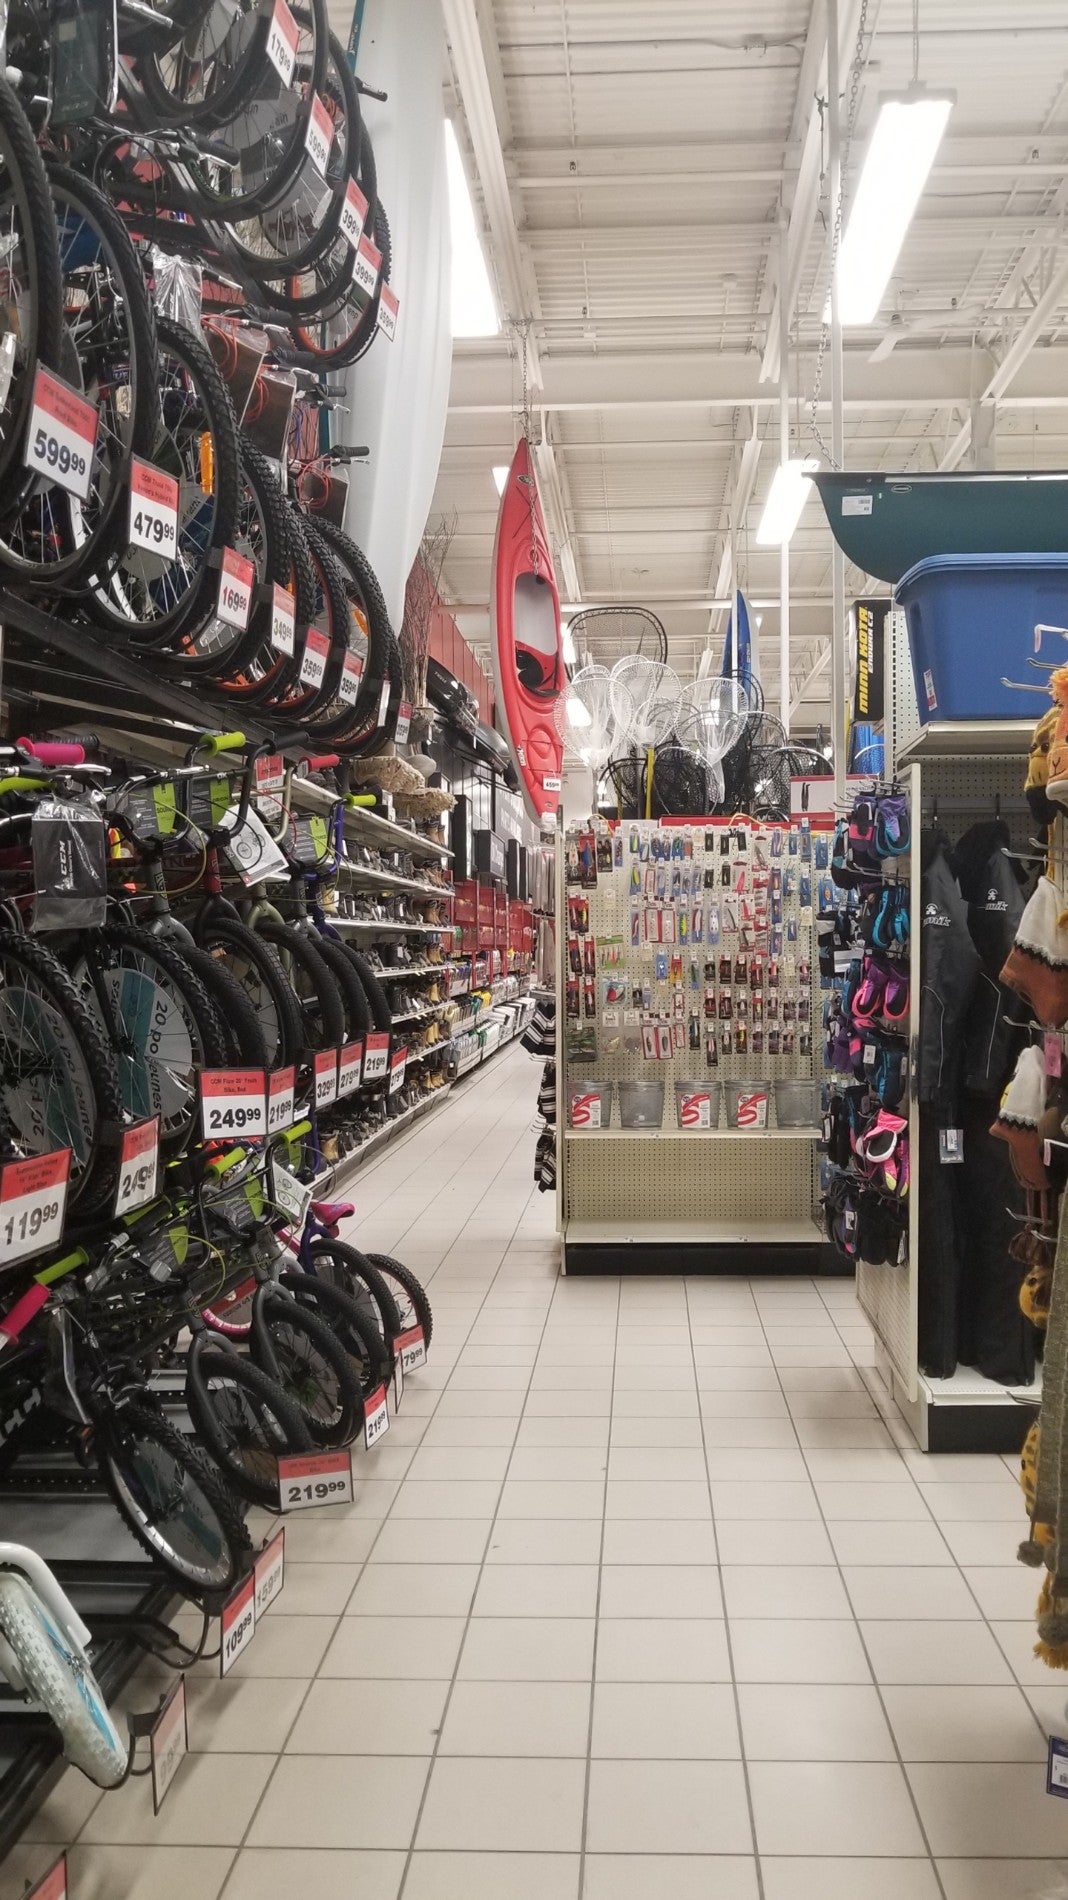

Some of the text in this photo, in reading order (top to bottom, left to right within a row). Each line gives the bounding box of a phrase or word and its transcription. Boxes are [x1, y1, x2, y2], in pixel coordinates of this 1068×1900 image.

[33, 428, 86, 476] 59999
[134, 511, 175, 543] 47999
[222, 585, 247, 612] 16999
[59, 840, 67, 875] CCM
[154, 1000, 168, 1026] 20
[209, 1107, 261, 1129] 24999
[269, 1100, 292, 1125] 21999
[5, 1201, 59, 1246] 11999
[403, 1347, 423, 1367] 7999
[367, 1410, 386, 1439] 21999
[288, 1480, 346, 1503] 21999
[226, 1612, 252, 1658] 10999
